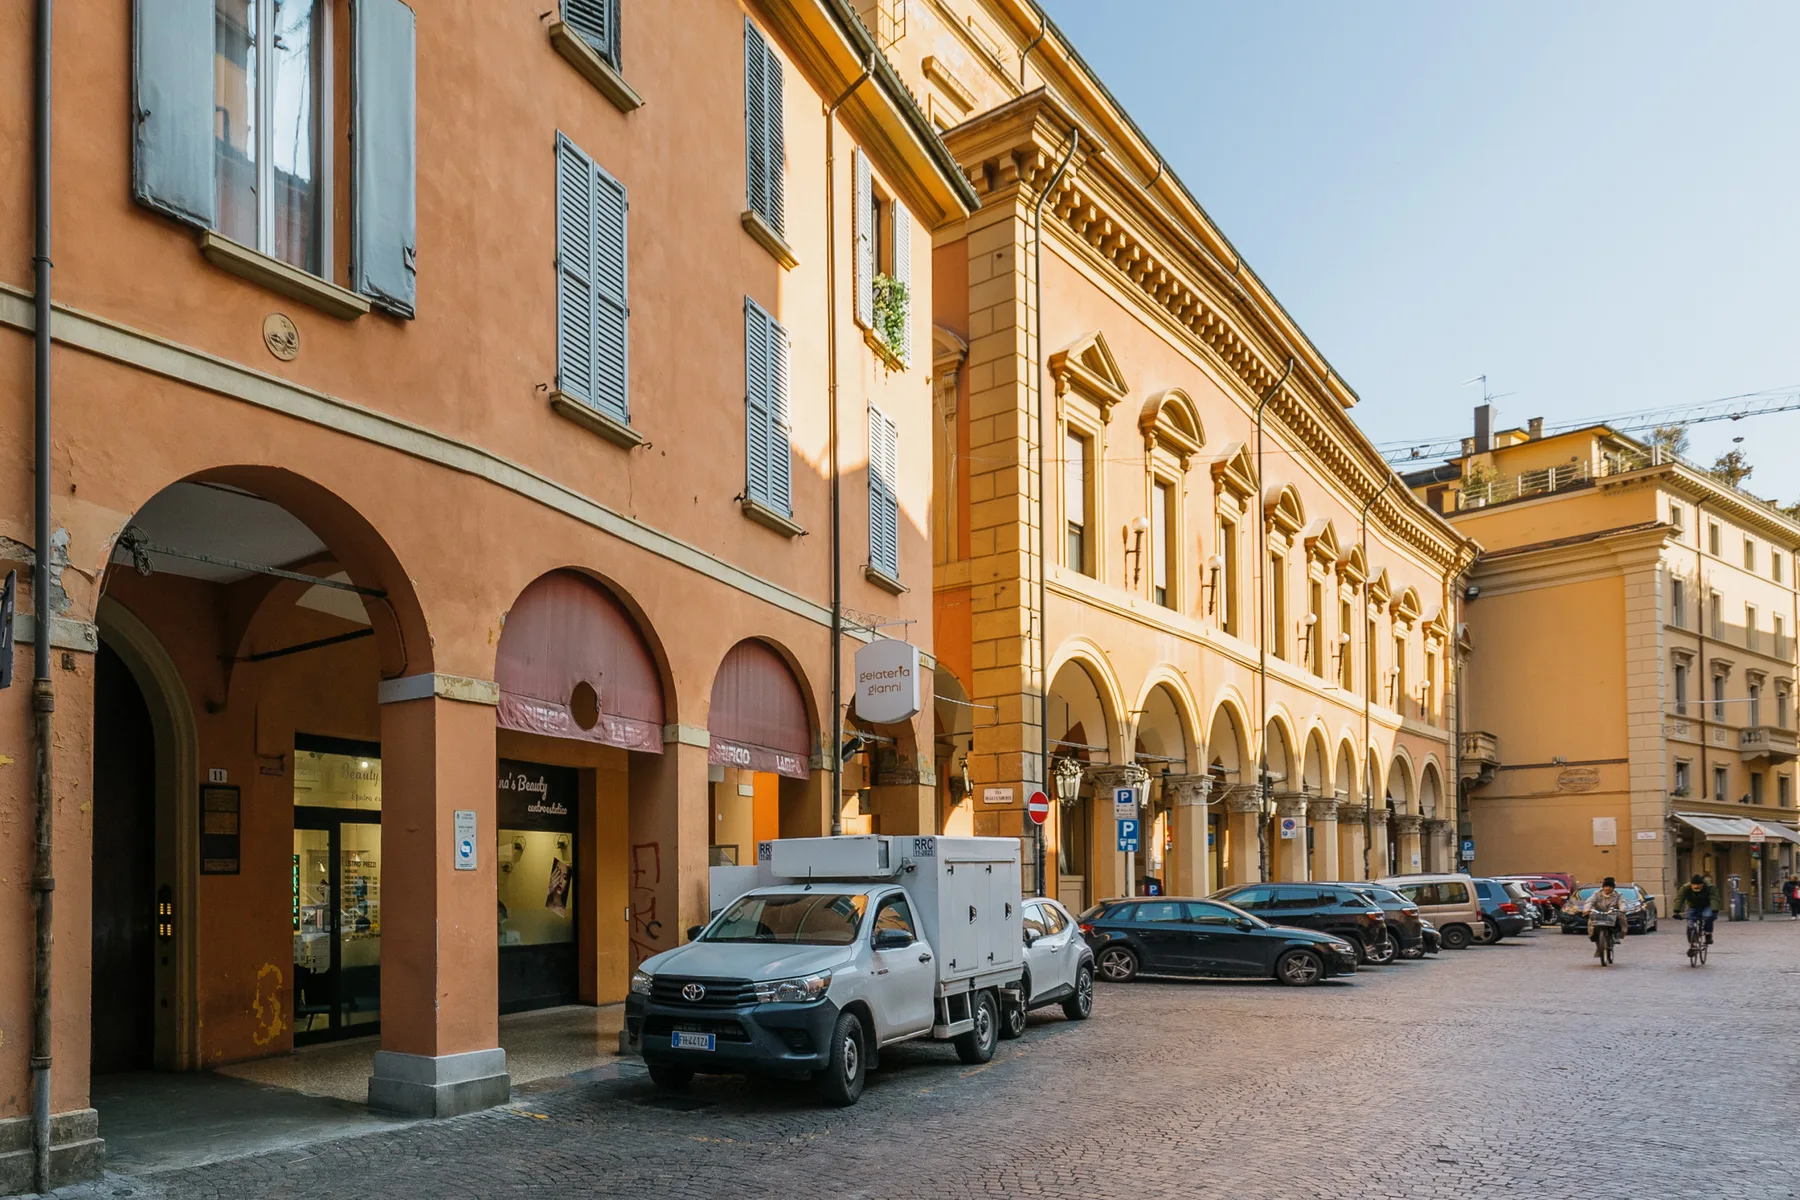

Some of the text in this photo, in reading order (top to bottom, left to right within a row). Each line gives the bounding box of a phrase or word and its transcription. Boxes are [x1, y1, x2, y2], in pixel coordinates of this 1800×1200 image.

[859, 666, 910, 682] gelateria
[868, 682, 901, 696] gianni
[213, 770, 223, 781] 11
[341, 763, 379, 787] Beauty
[517, 774, 548, 801] Beauty
[1121, 791, 1129, 802] P
[1123, 822, 1134, 837] P
[760, 844, 772, 854] RR
[915, 838, 933, 850] RRC
[1464, 841, 1472, 850] P
[1149, 885, 1158, 895] P
